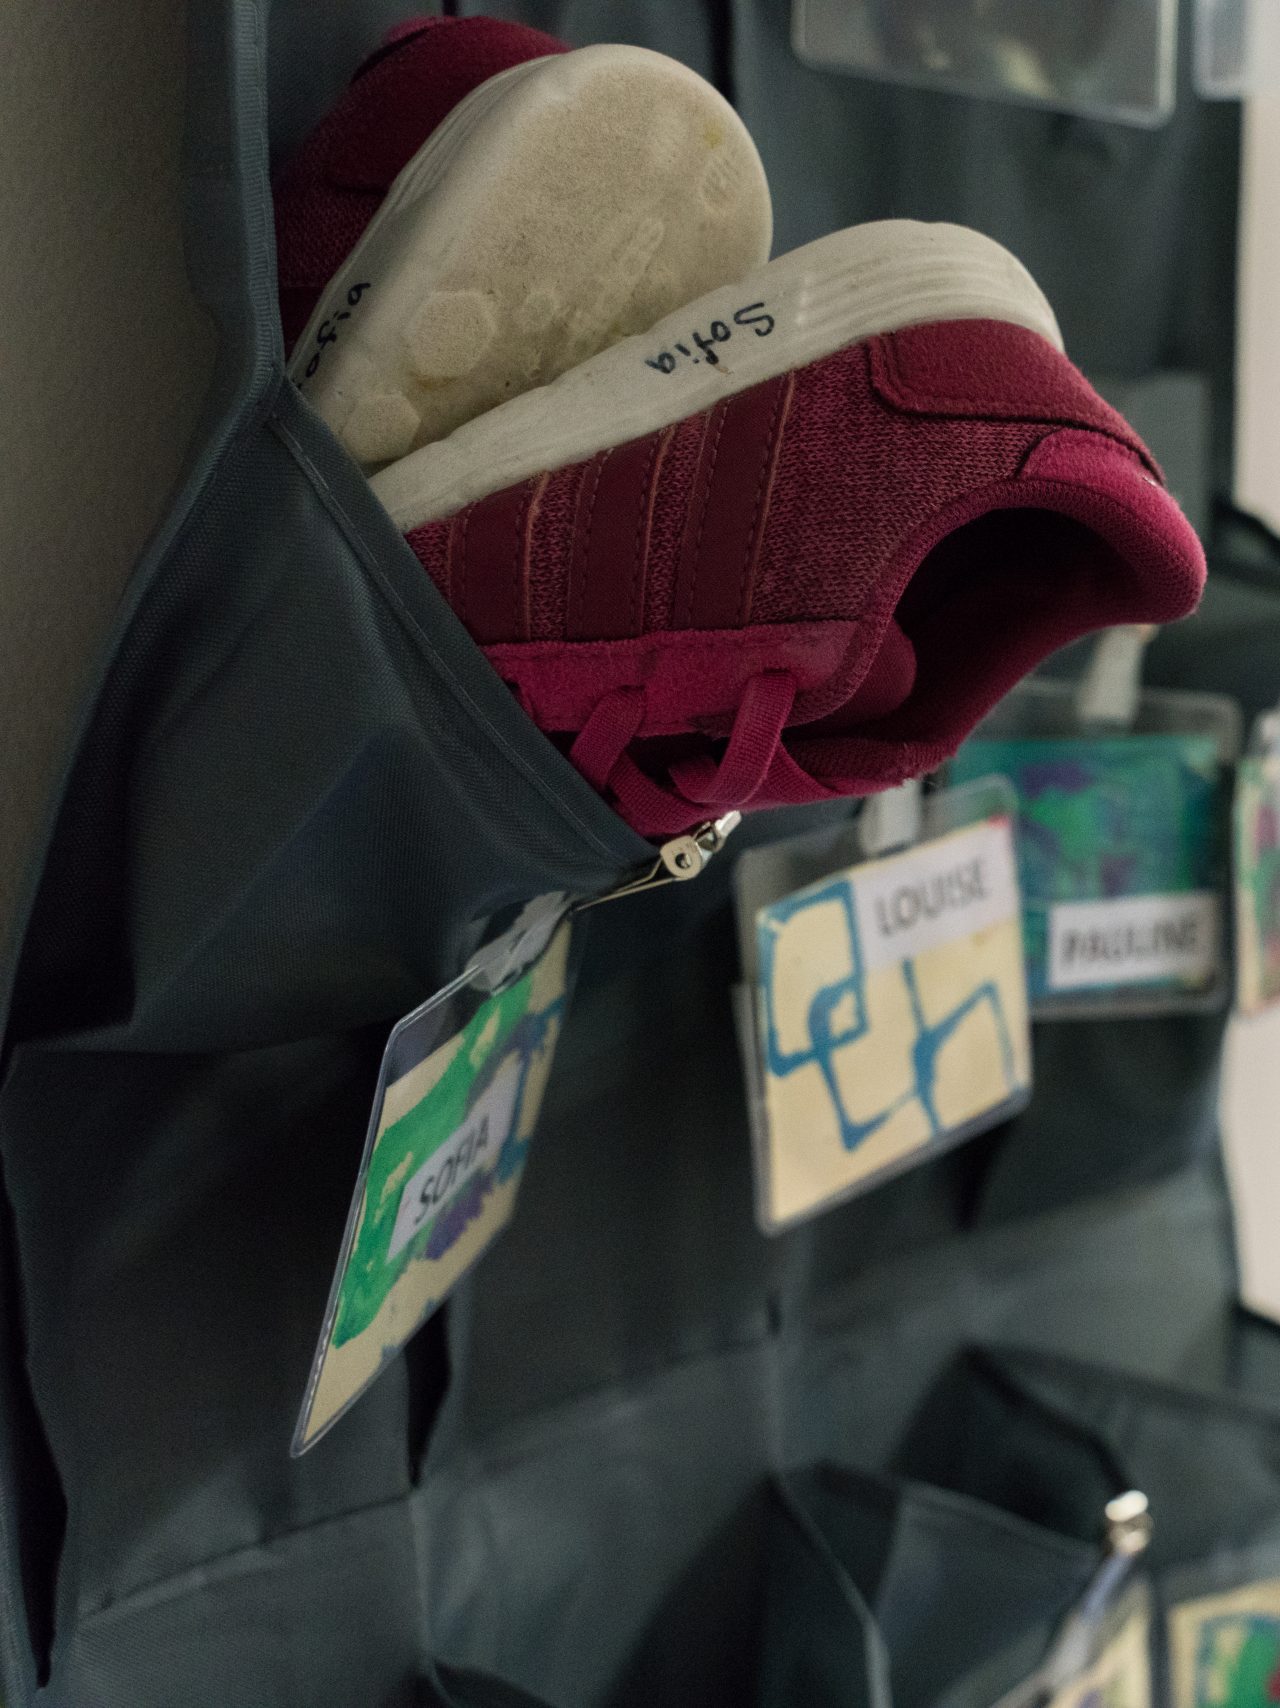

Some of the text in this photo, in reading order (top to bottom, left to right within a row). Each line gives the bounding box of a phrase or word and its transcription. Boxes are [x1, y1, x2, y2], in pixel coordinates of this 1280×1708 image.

[293, 283, 371, 389] ofia
[646, 302, 775, 375] Sofia
[873, 856, 989, 937] LOUISE
[1060, 914, 1200, 967] PAULINE
[413, 1114, 492, 1224] SOFIA
